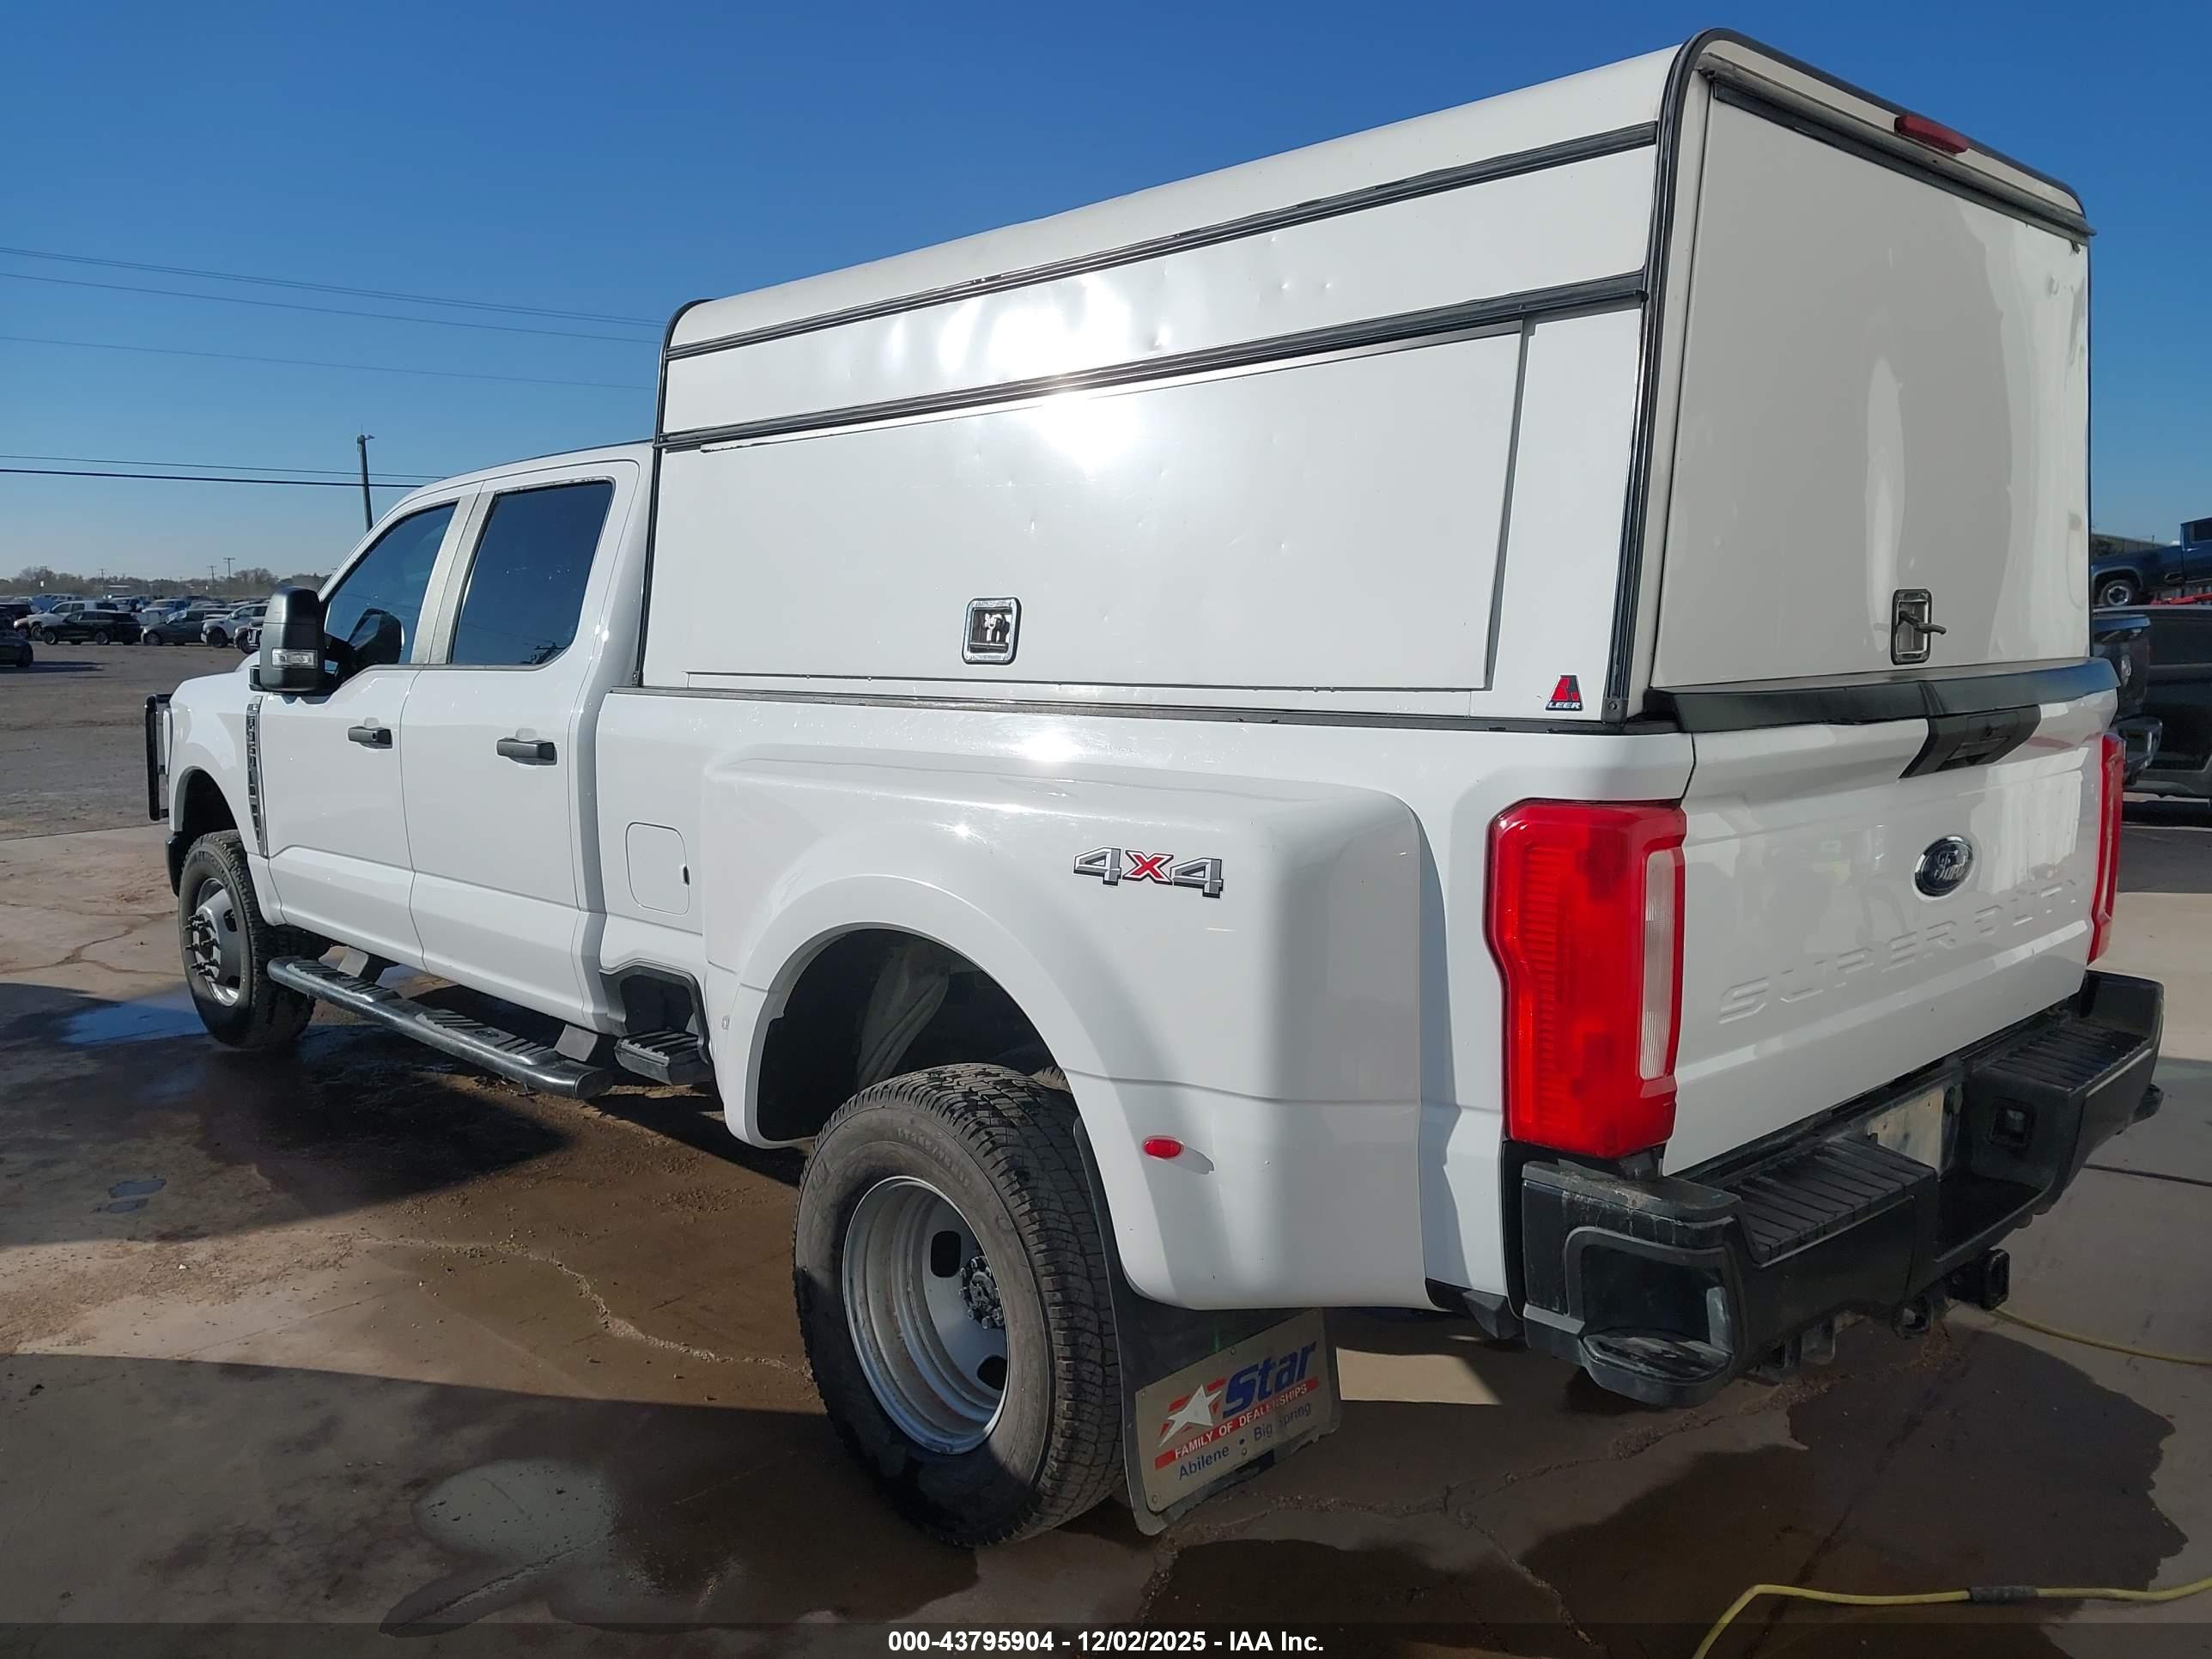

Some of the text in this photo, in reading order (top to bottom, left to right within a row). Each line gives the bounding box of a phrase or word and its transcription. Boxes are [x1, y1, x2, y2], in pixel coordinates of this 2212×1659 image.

[1934, 849, 1966, 880] Ford
[1717, 919, 1959, 1024] SUPER
[1223, 1341, 1316, 1419] Star
[1175, 1431, 1213, 1459] FAMILY
[1218, 1421, 1233, 1437] OF
[1179, 1446, 1230, 1480] Abilene
[1254, 1423, 1273, 1442] Big
